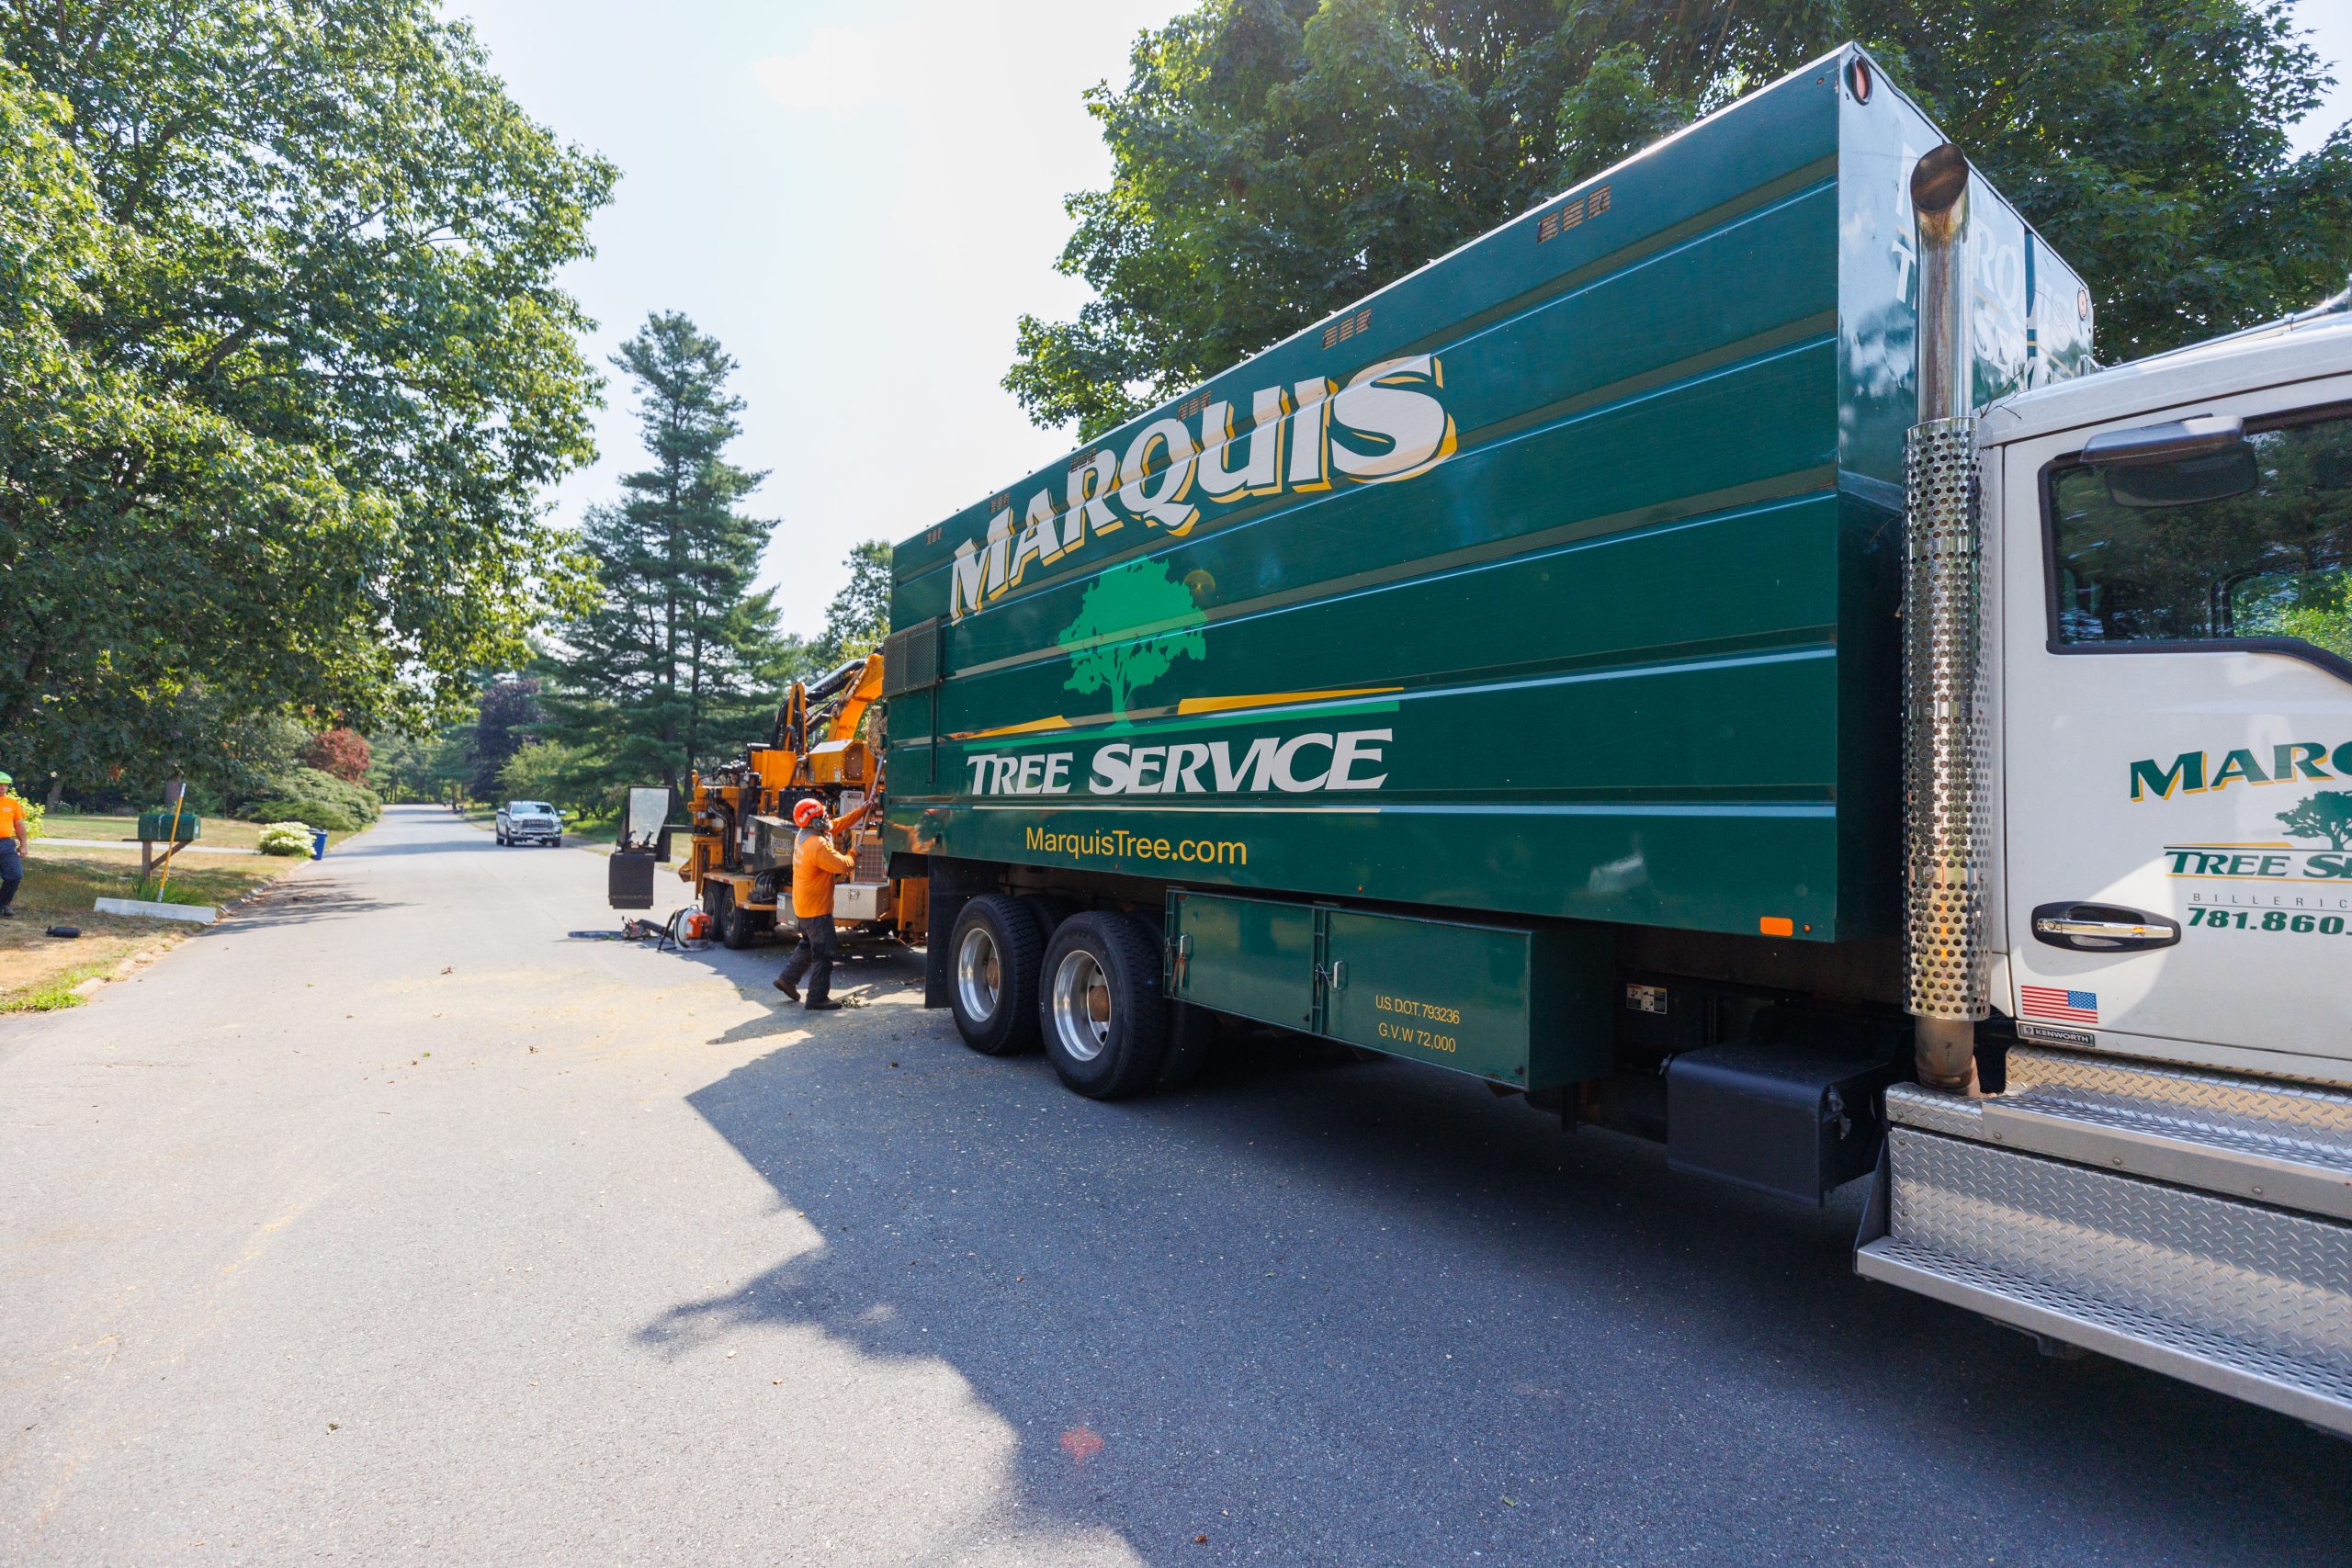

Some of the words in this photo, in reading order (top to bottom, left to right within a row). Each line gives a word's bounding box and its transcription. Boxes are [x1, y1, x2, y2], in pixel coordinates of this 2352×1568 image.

[951, 353, 1458, 626] MARQUIS
[967, 751, 1073, 795] TREE
[1089, 728, 1393, 795] SERVICE
[1025, 826, 1247, 866] MarquisTree.com
[2165, 851, 2290, 877] TREE
[2193, 892, 2348, 908] BILLERIC
[1421, 1003, 1460, 1025] 793236
[1417, 1030, 1456, 1054] 72,000
[2035, 1029, 2089, 1043] KENWORTH
